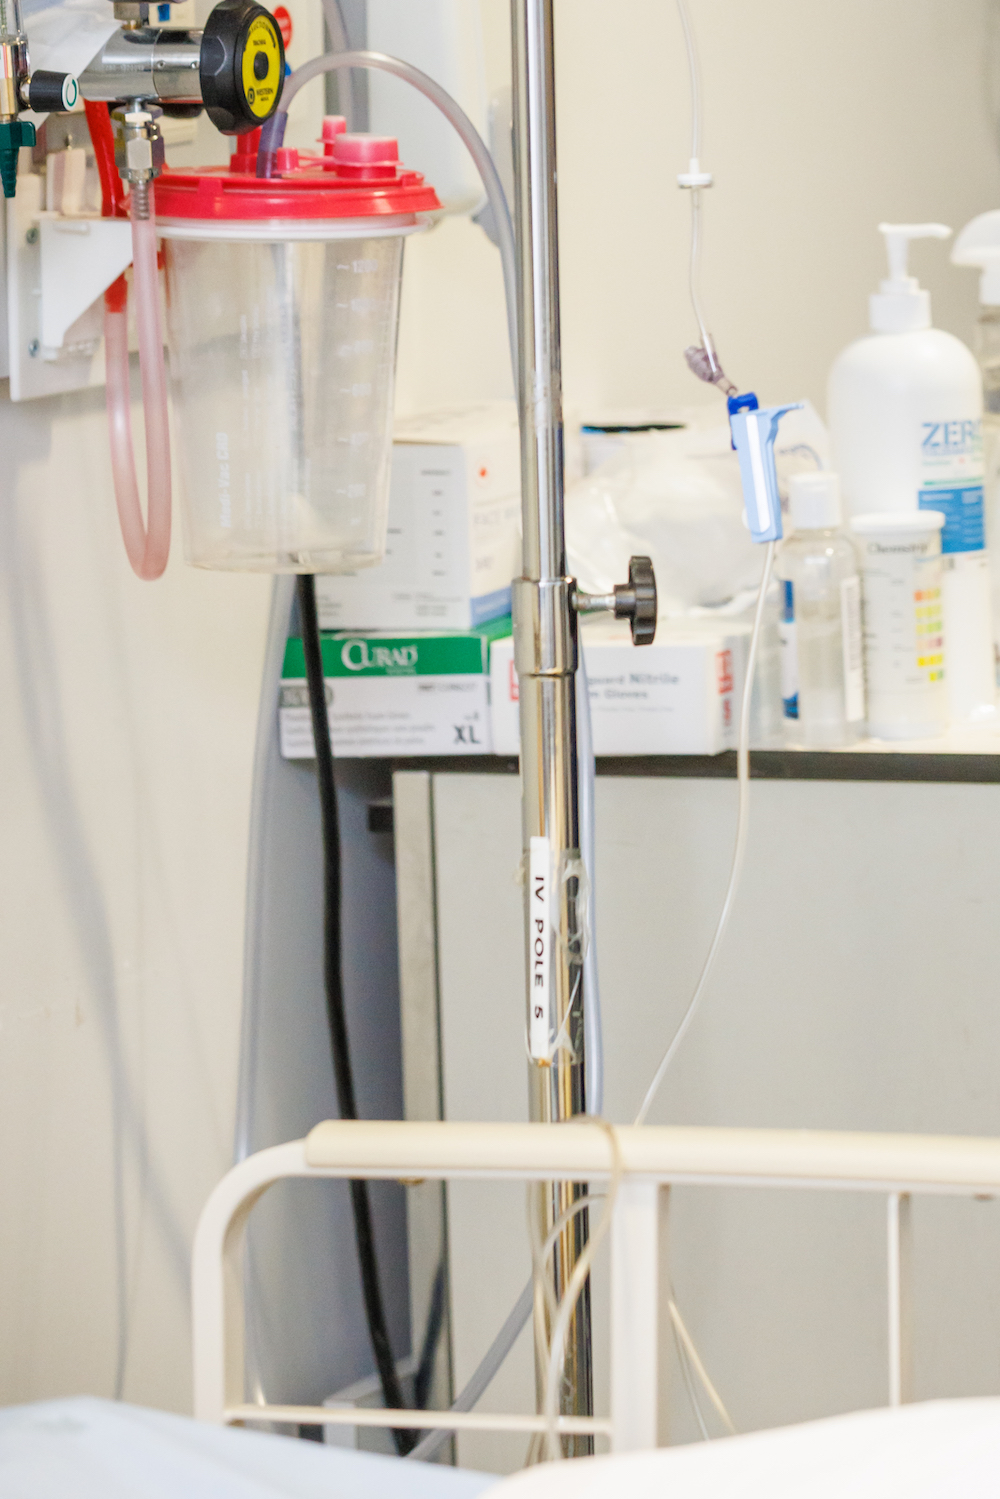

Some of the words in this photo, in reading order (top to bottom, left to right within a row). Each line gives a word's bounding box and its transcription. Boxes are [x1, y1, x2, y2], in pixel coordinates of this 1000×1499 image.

[453, 724, 481, 745] XL
[534, 876, 545, 902] IV
[534, 918, 544, 988] POLE
[534, 1006, 544, 1019] 5
